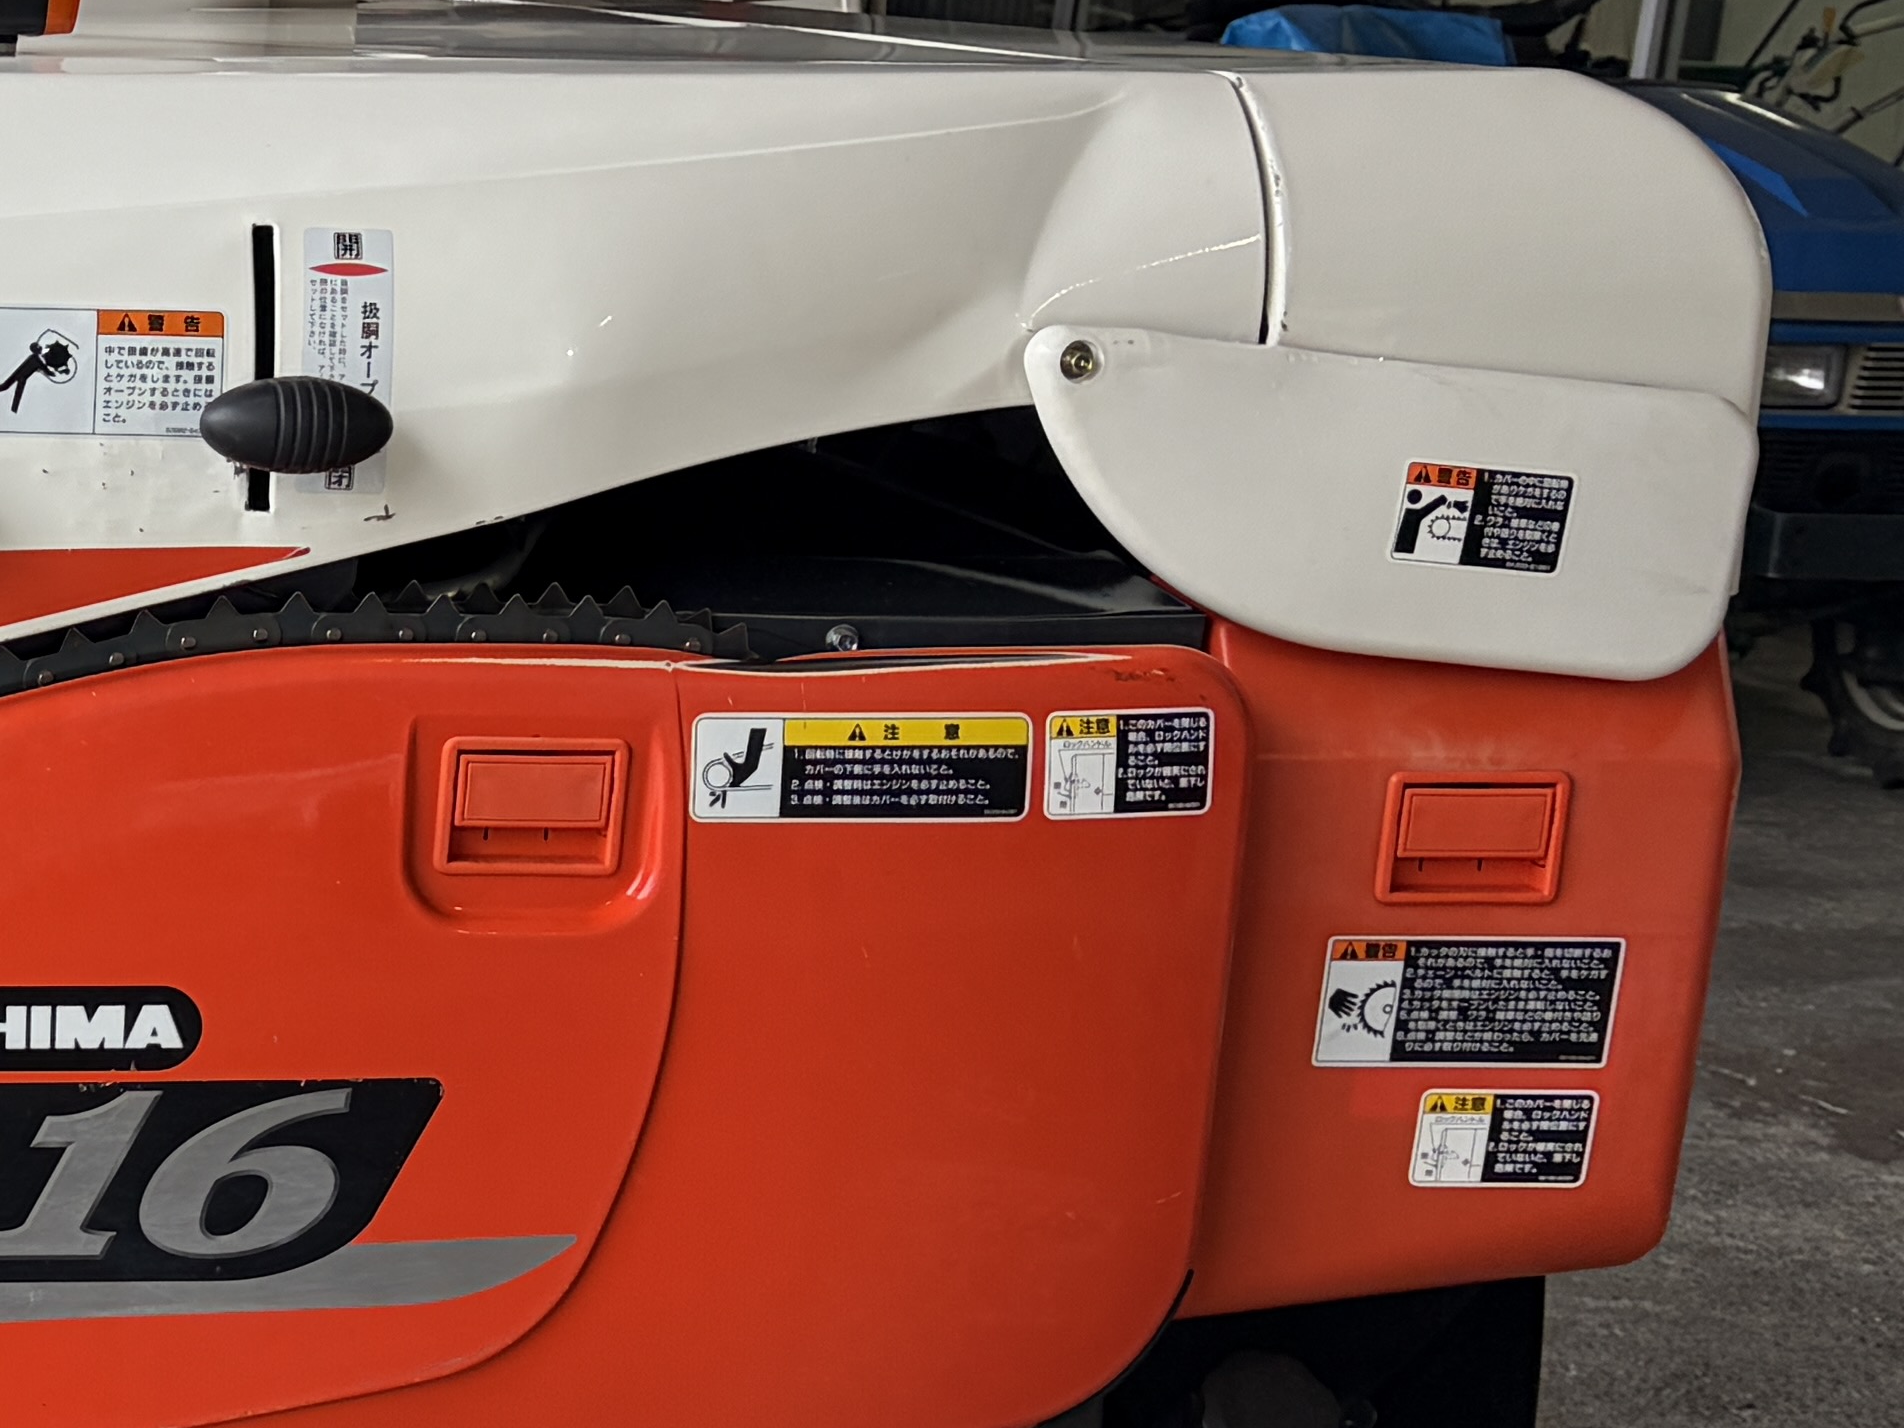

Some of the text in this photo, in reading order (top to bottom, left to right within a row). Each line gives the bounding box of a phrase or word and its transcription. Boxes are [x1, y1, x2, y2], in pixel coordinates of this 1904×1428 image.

[335, 233, 361, 259] 開
[360, 302, 380, 395] 扱胴オープ
[102, 400, 203, 411] エンジンを必ず止め
[102, 413, 126, 423] こと。
[1079, 717, 1111, 734] 注意
